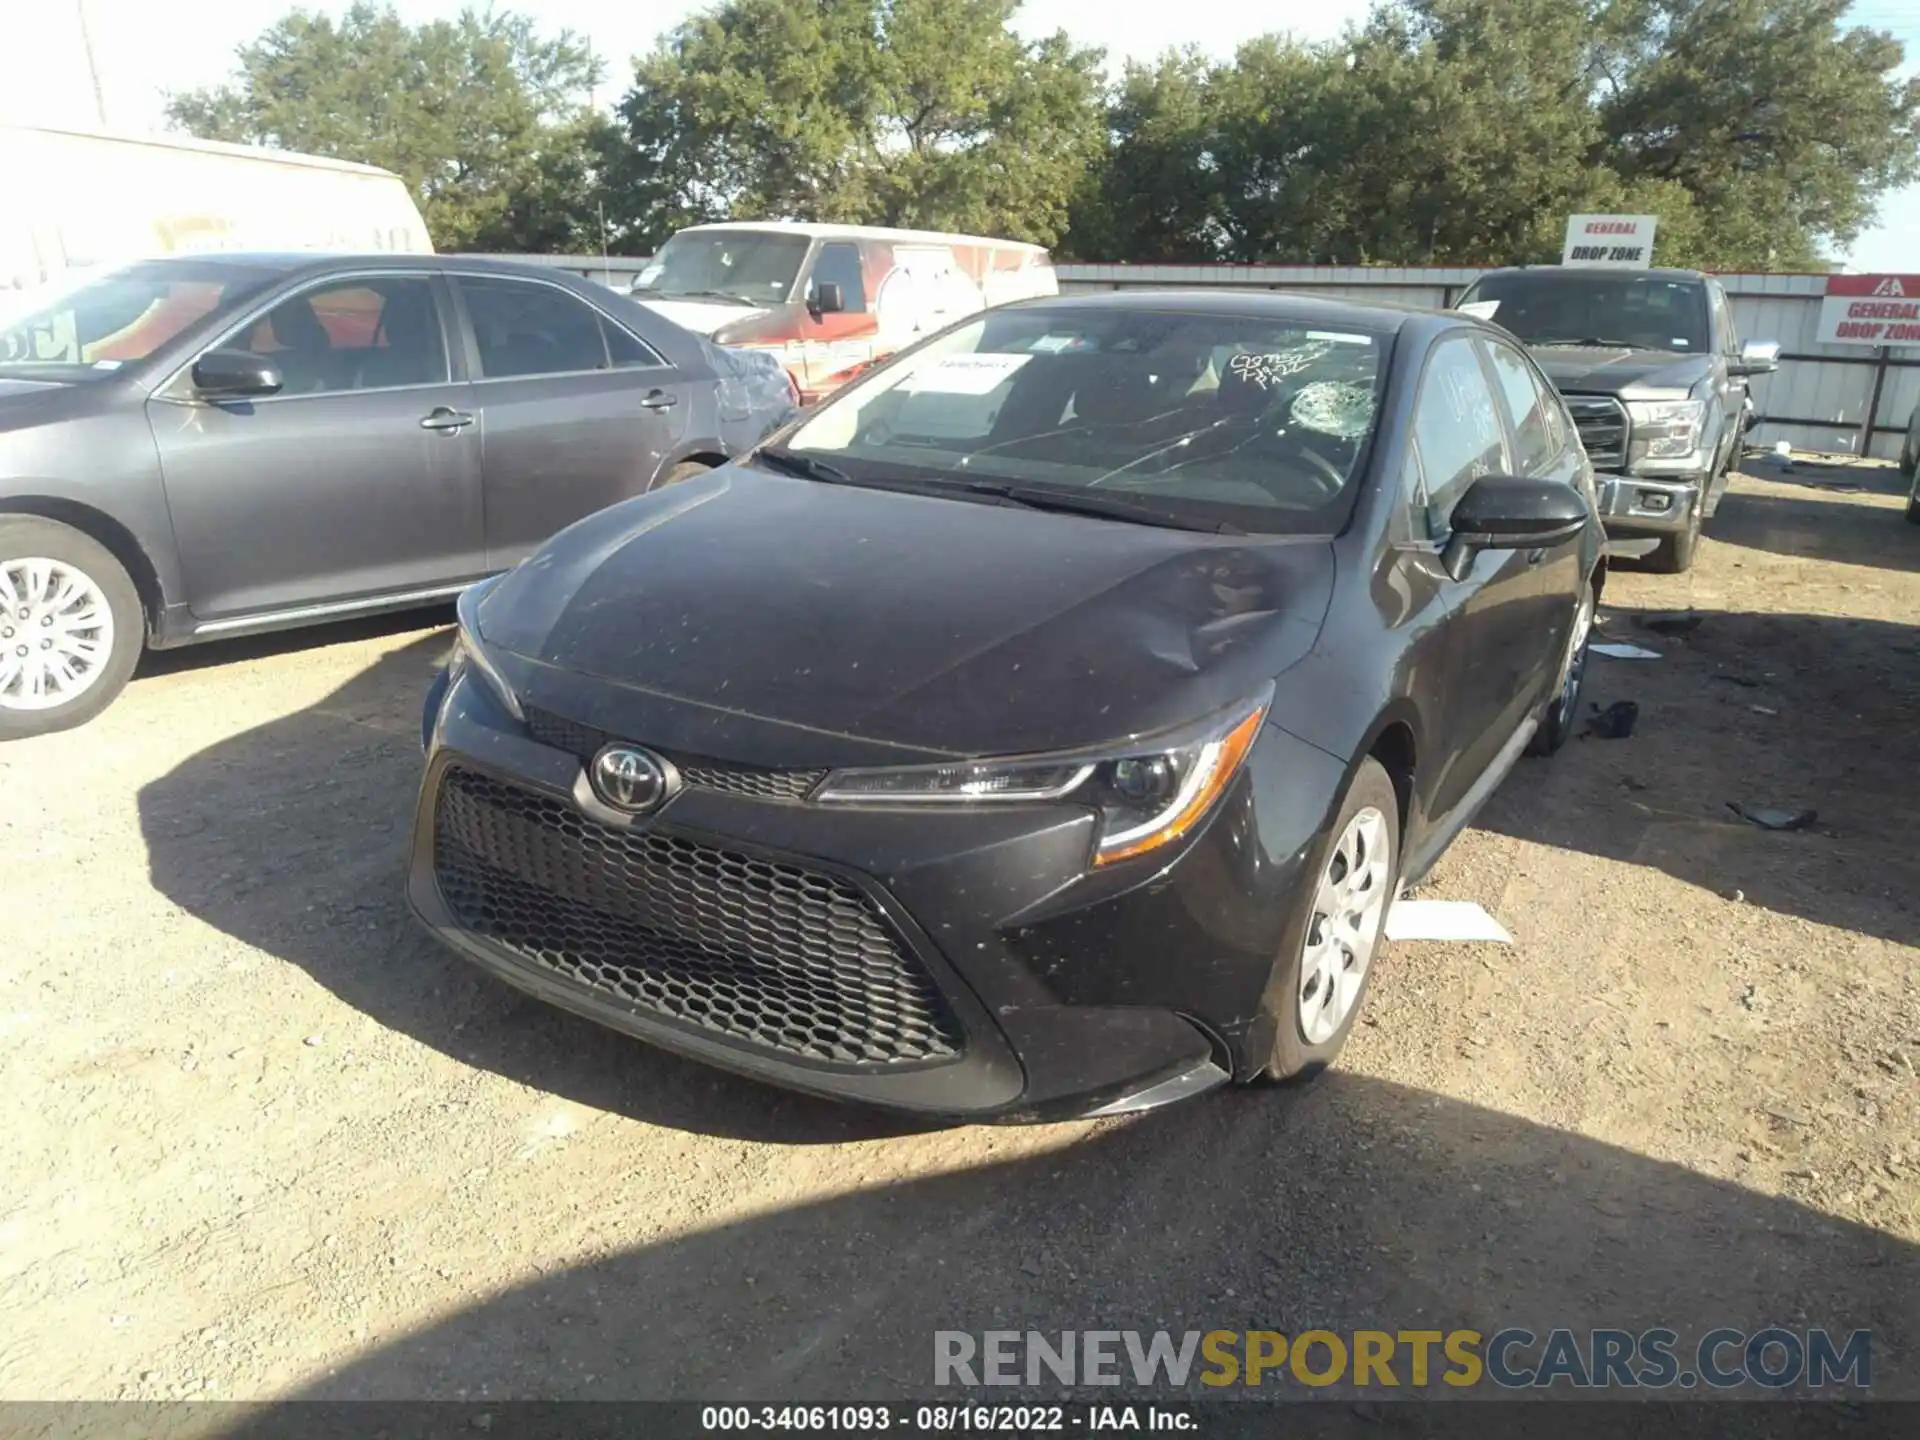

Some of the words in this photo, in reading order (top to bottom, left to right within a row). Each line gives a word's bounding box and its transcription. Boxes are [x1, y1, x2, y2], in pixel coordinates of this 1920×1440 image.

[1584, 222, 1637, 235] GENERAL
[1571, 246, 1607, 260] DROP
[1608, 246, 1644, 260] ZONE
[1847, 302, 1918, 319] GENERAL
[1836, 321, 1883, 338] DROP
